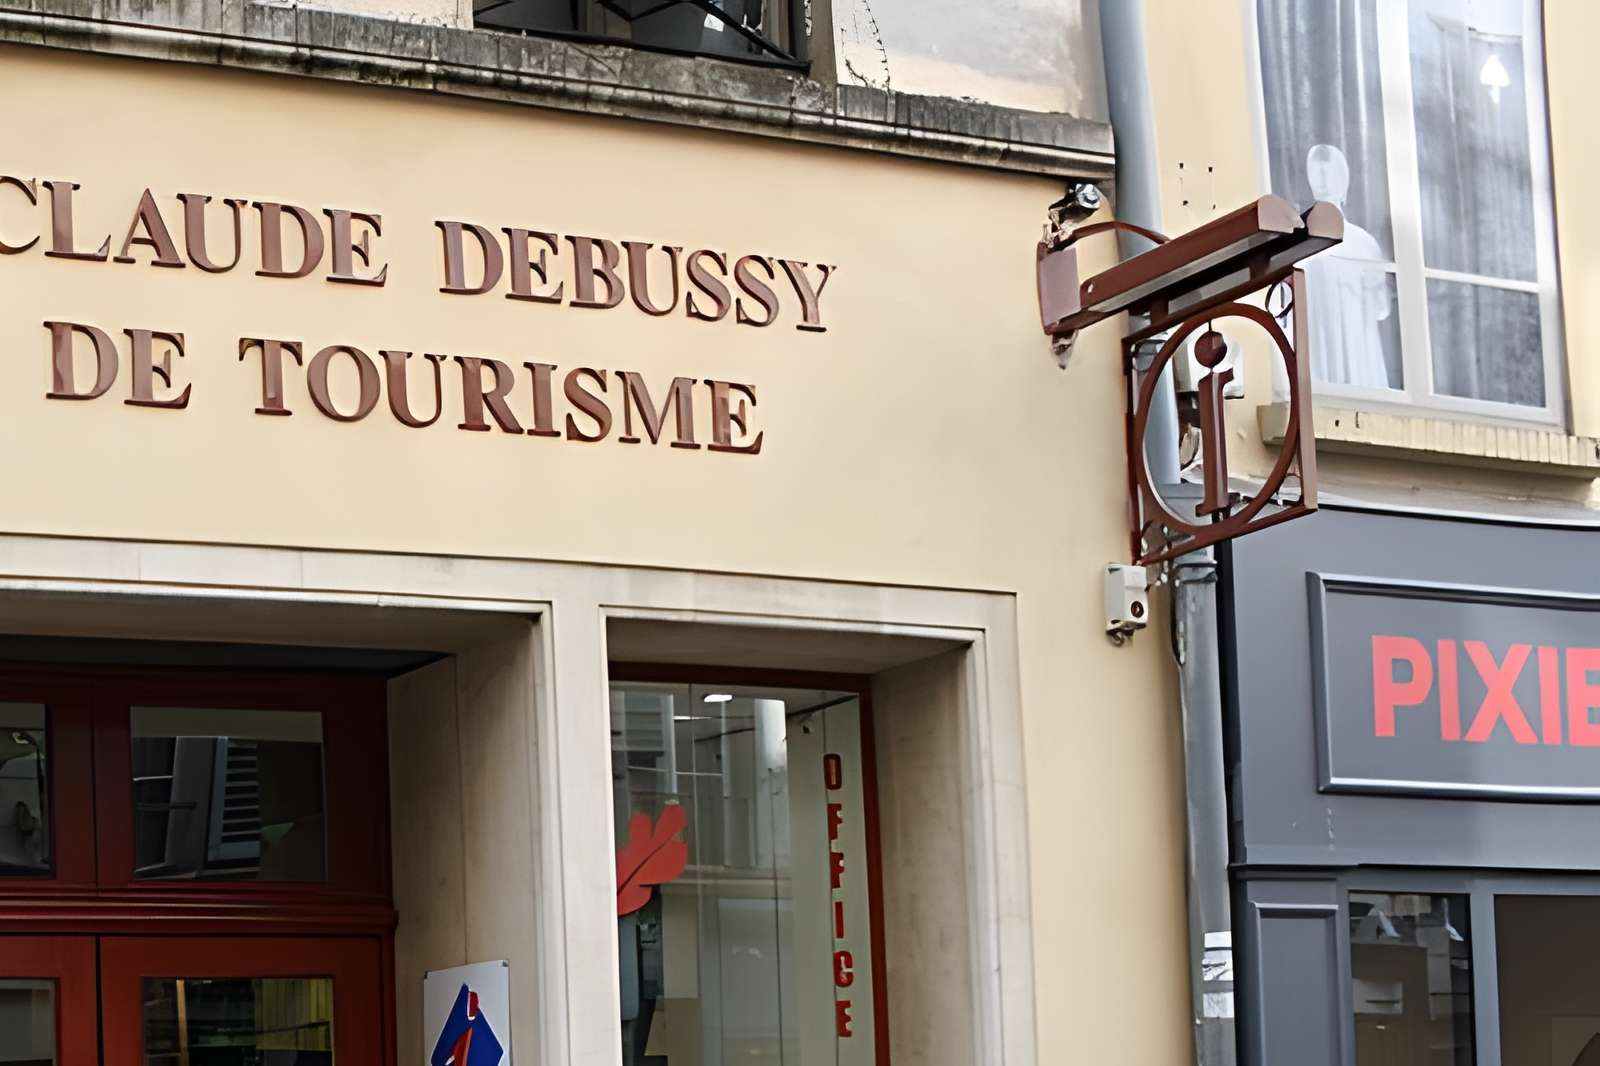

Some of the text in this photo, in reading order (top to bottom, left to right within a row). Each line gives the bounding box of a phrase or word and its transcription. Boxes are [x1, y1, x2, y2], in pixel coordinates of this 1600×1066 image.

[434, 219, 837, 334] DEBUSSY
[43, 320, 193, 411] DE
[238, 336, 764, 455] TOURISME
[1371, 634, 1600, 748] PIXIE
